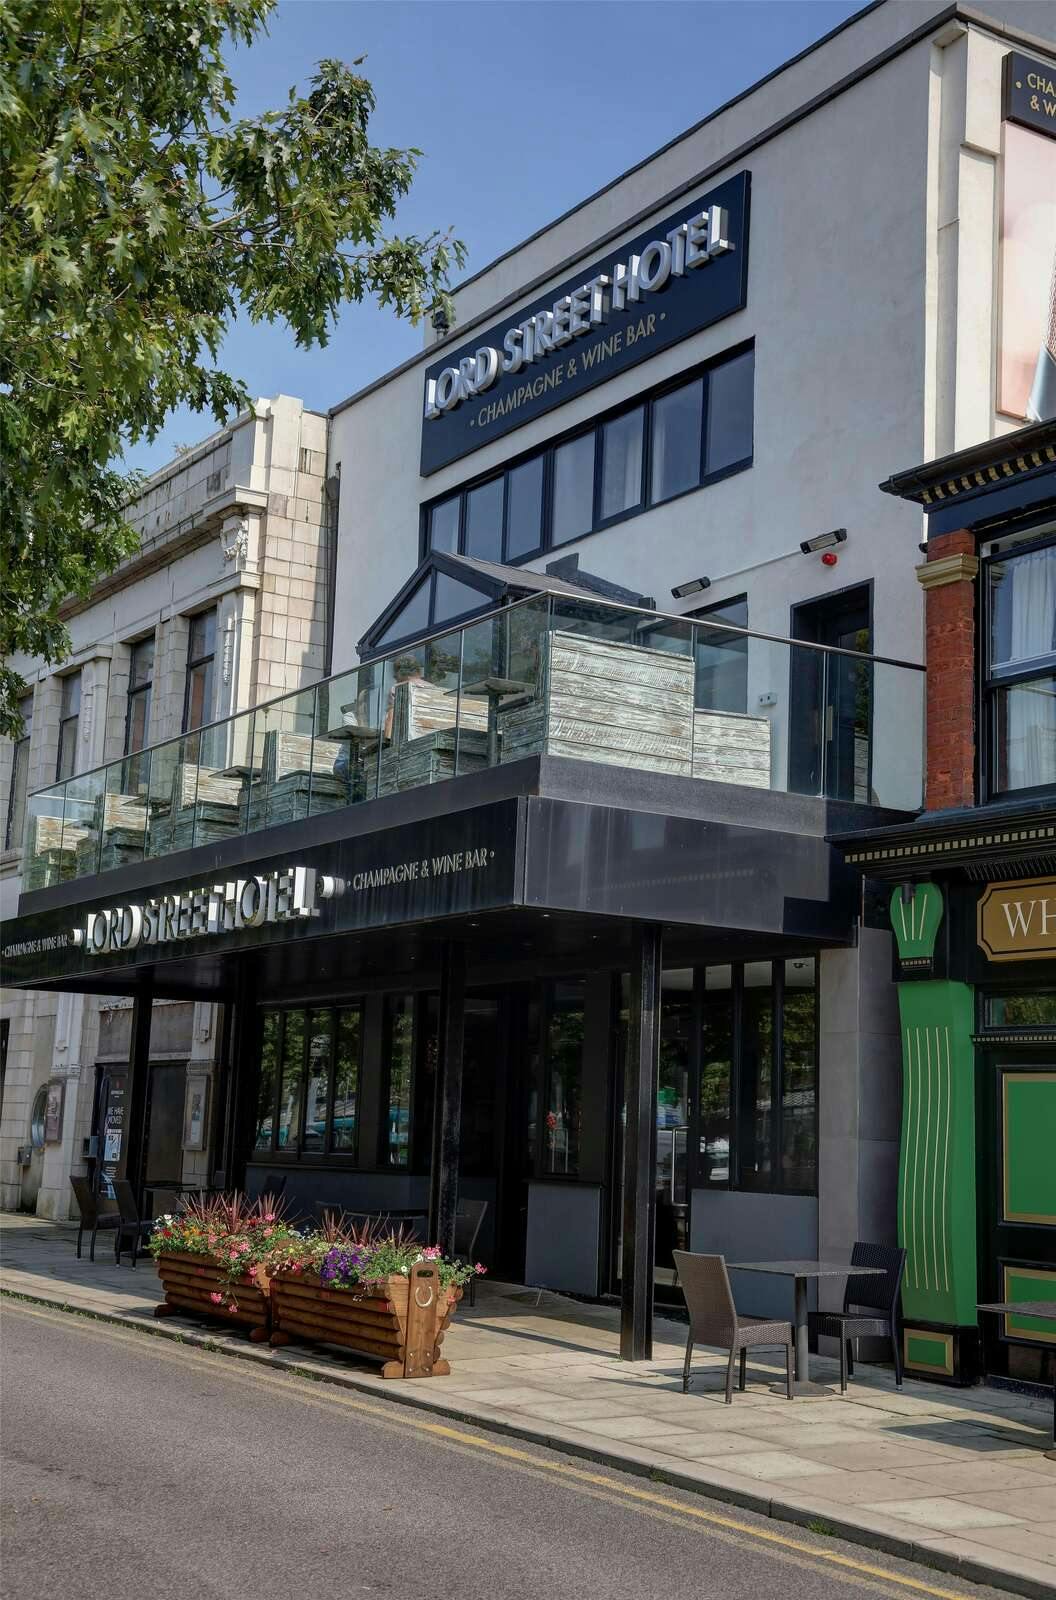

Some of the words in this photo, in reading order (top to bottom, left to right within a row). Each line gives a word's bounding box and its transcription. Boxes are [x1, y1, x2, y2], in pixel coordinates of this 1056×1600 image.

[1027, 73, 1056, 97] CHA
[1030, 95, 1040, 111] &
[424, 346, 498, 420] LORD
[502, 274, 609, 374] STREET
[613, 205, 731, 310] HOTEL
[477, 369, 563, 427] CHAMPAGNE
[567, 358, 578, 379] &
[581, 336, 622, 371] WINE
[626, 313, 656, 345] BAR
[353, 861, 419, 891] CHAMPAGNE
[421, 859, 429, 878] &
[432, 852, 463, 876] WINE
[465, 847, 487, 869] BAR
[86, 905, 144, 954] LORD
[143, 883, 224, 945] STREET
[223, 866, 318, 931] HOTEL
